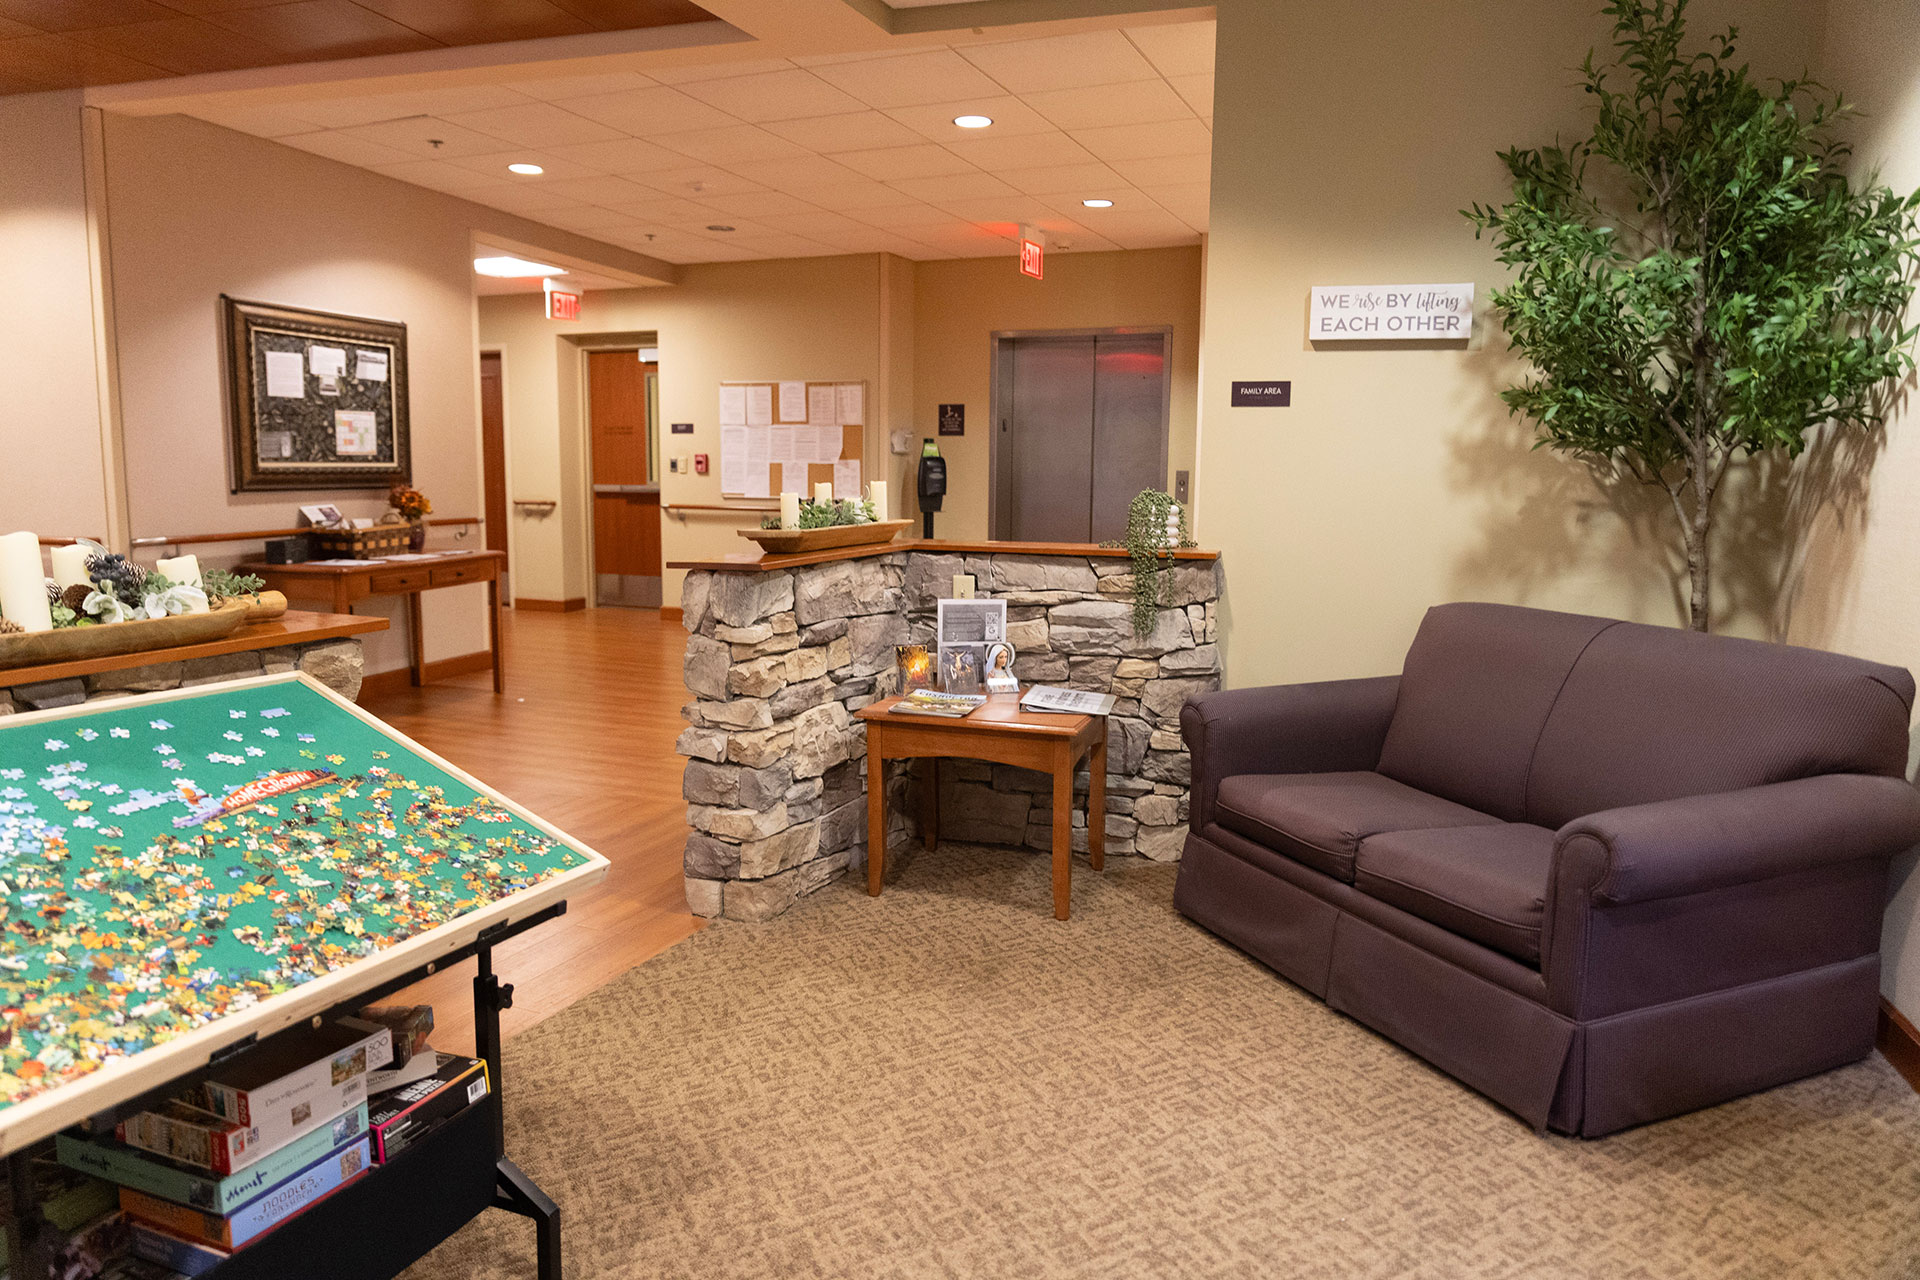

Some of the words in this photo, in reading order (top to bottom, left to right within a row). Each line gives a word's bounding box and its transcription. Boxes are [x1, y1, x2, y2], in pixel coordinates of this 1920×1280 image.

[1025, 242, 1040, 275] EXIT
[552, 292, 577, 319] EXIT
[1321, 294, 1350, 308] WE
[1353, 292, 1384, 311] rise
[1386, 293, 1412, 308] BY
[1416, 290, 1460, 312] lifting
[1321, 316, 1379, 332] EACH
[1387, 315, 1460, 331] OTHER
[1240, 387, 1263, 395] FAMILY
[226, 771, 311, 808] HOMEGROWN
[368, 1036, 389, 1052] 500
